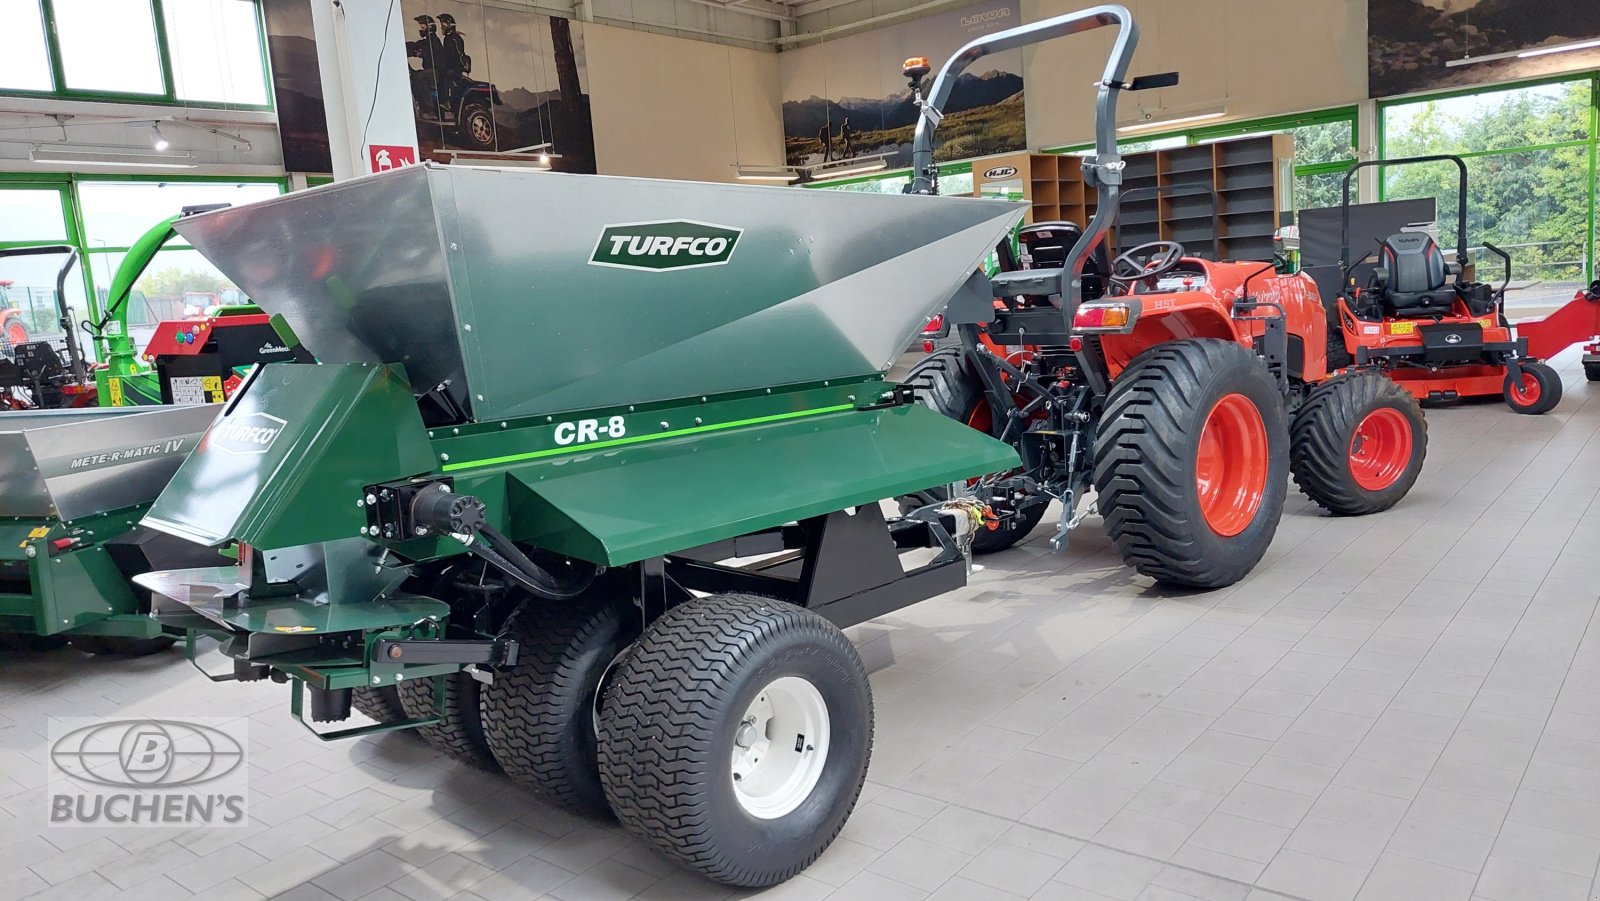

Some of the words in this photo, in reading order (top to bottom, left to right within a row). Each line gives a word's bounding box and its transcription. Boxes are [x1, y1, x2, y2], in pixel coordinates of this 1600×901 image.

[960, 7, 1011, 27] LOWA
[988, 168, 1012, 177] HJC
[610, 235, 728, 256] TURFCO
[554, 415, 626, 446] CR-8
[71, 445, 161, 469] METE-R-MATIC
[164, 438, 185, 454] IV
